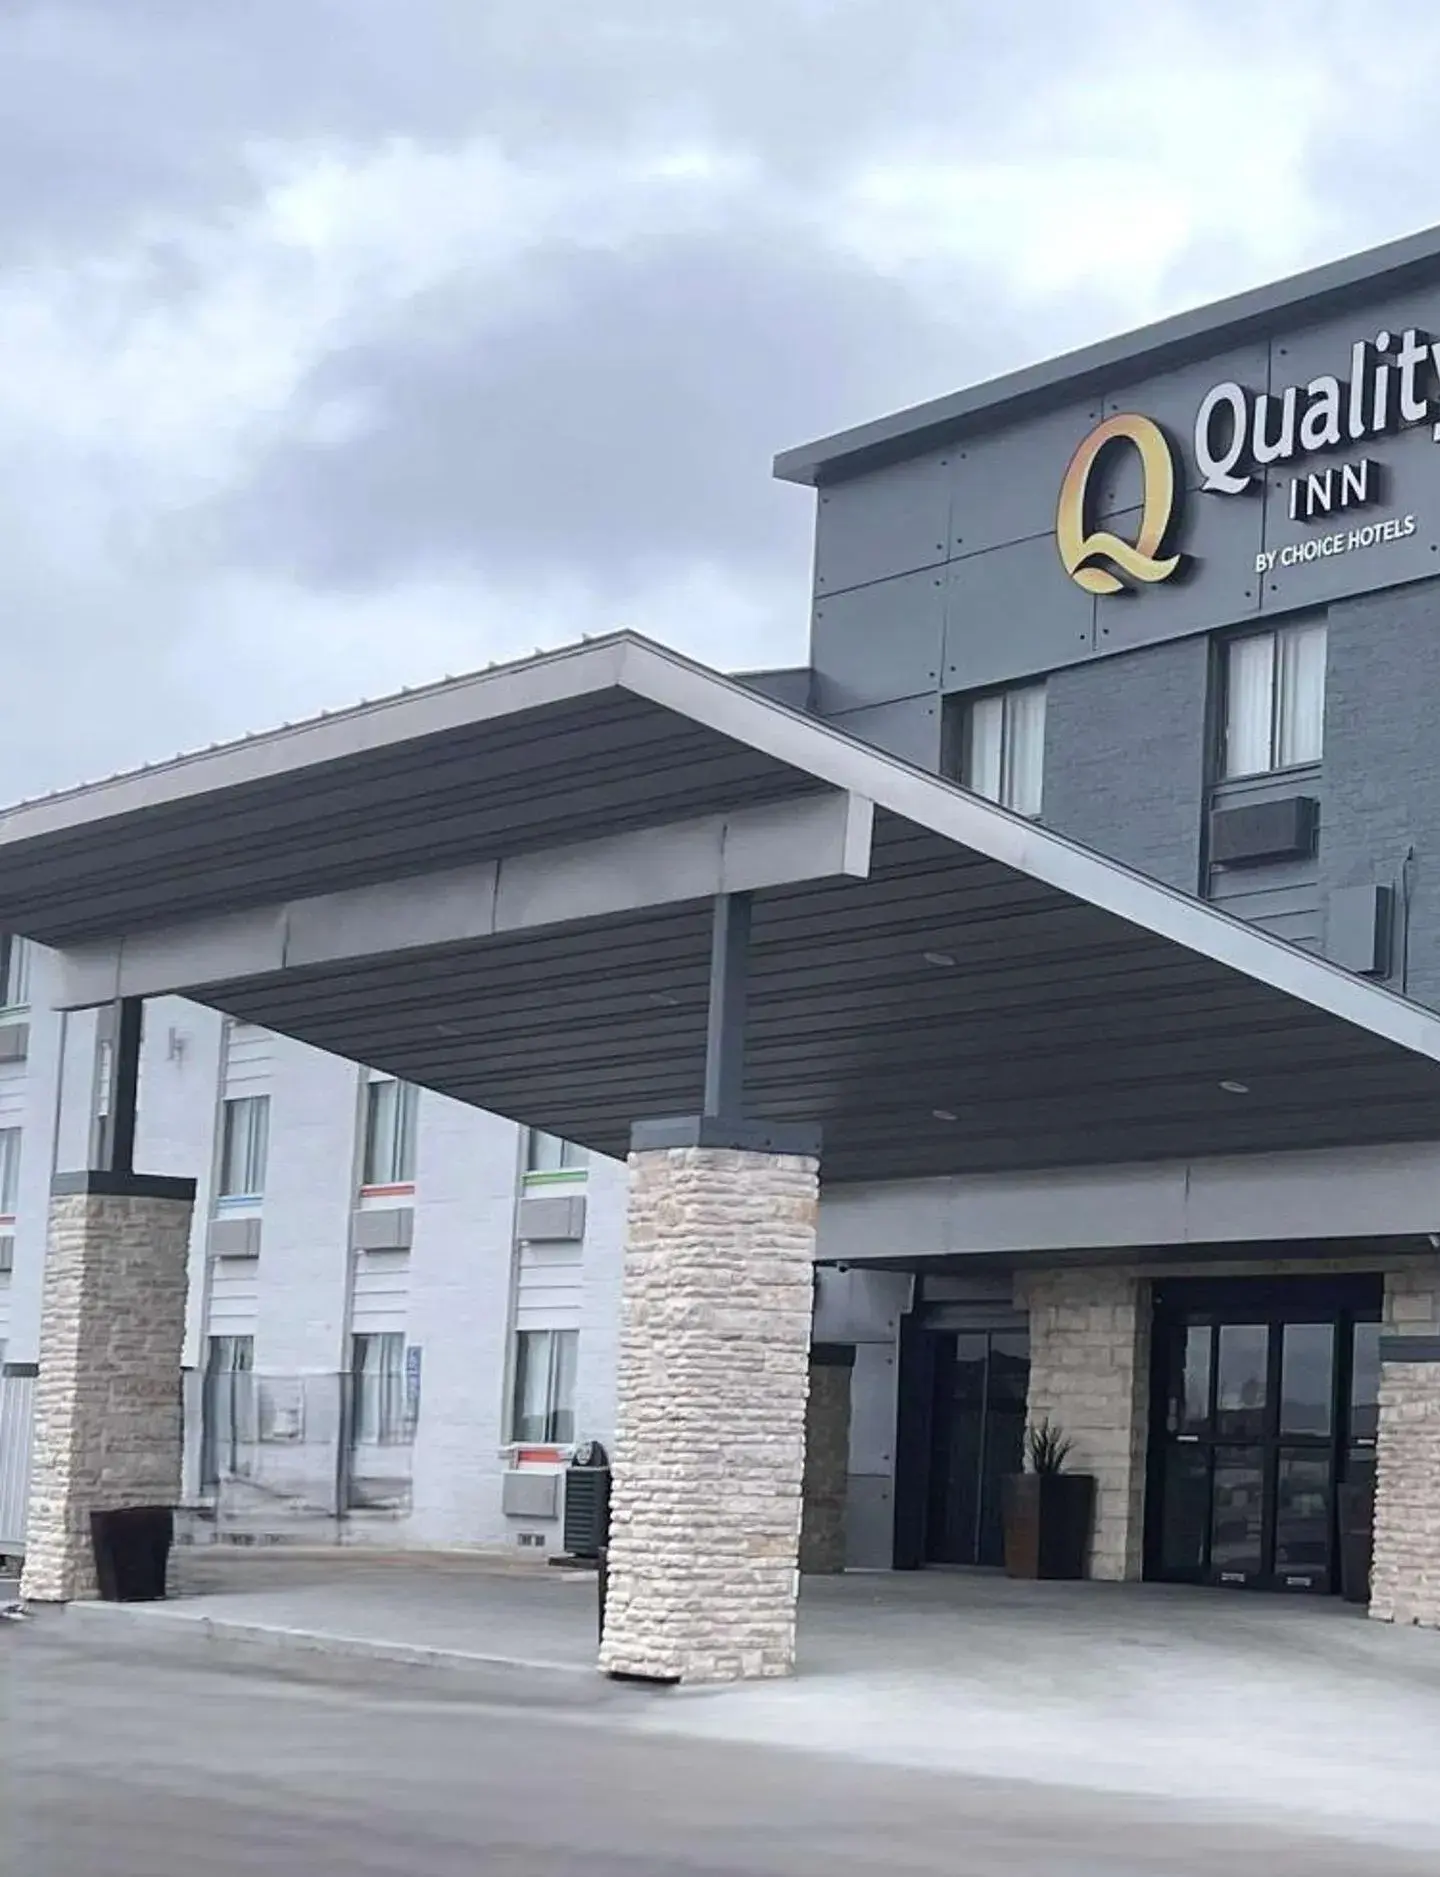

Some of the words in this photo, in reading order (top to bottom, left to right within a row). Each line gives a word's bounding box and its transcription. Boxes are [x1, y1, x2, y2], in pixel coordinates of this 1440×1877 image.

[1057, 413, 1180, 594] Q
[1289, 459, 1368, 519] INN
[1255, 550, 1277, 573] BY
[1281, 533, 1345, 566] CHOICE
[1348, 515, 1416, 551] HOTELS
